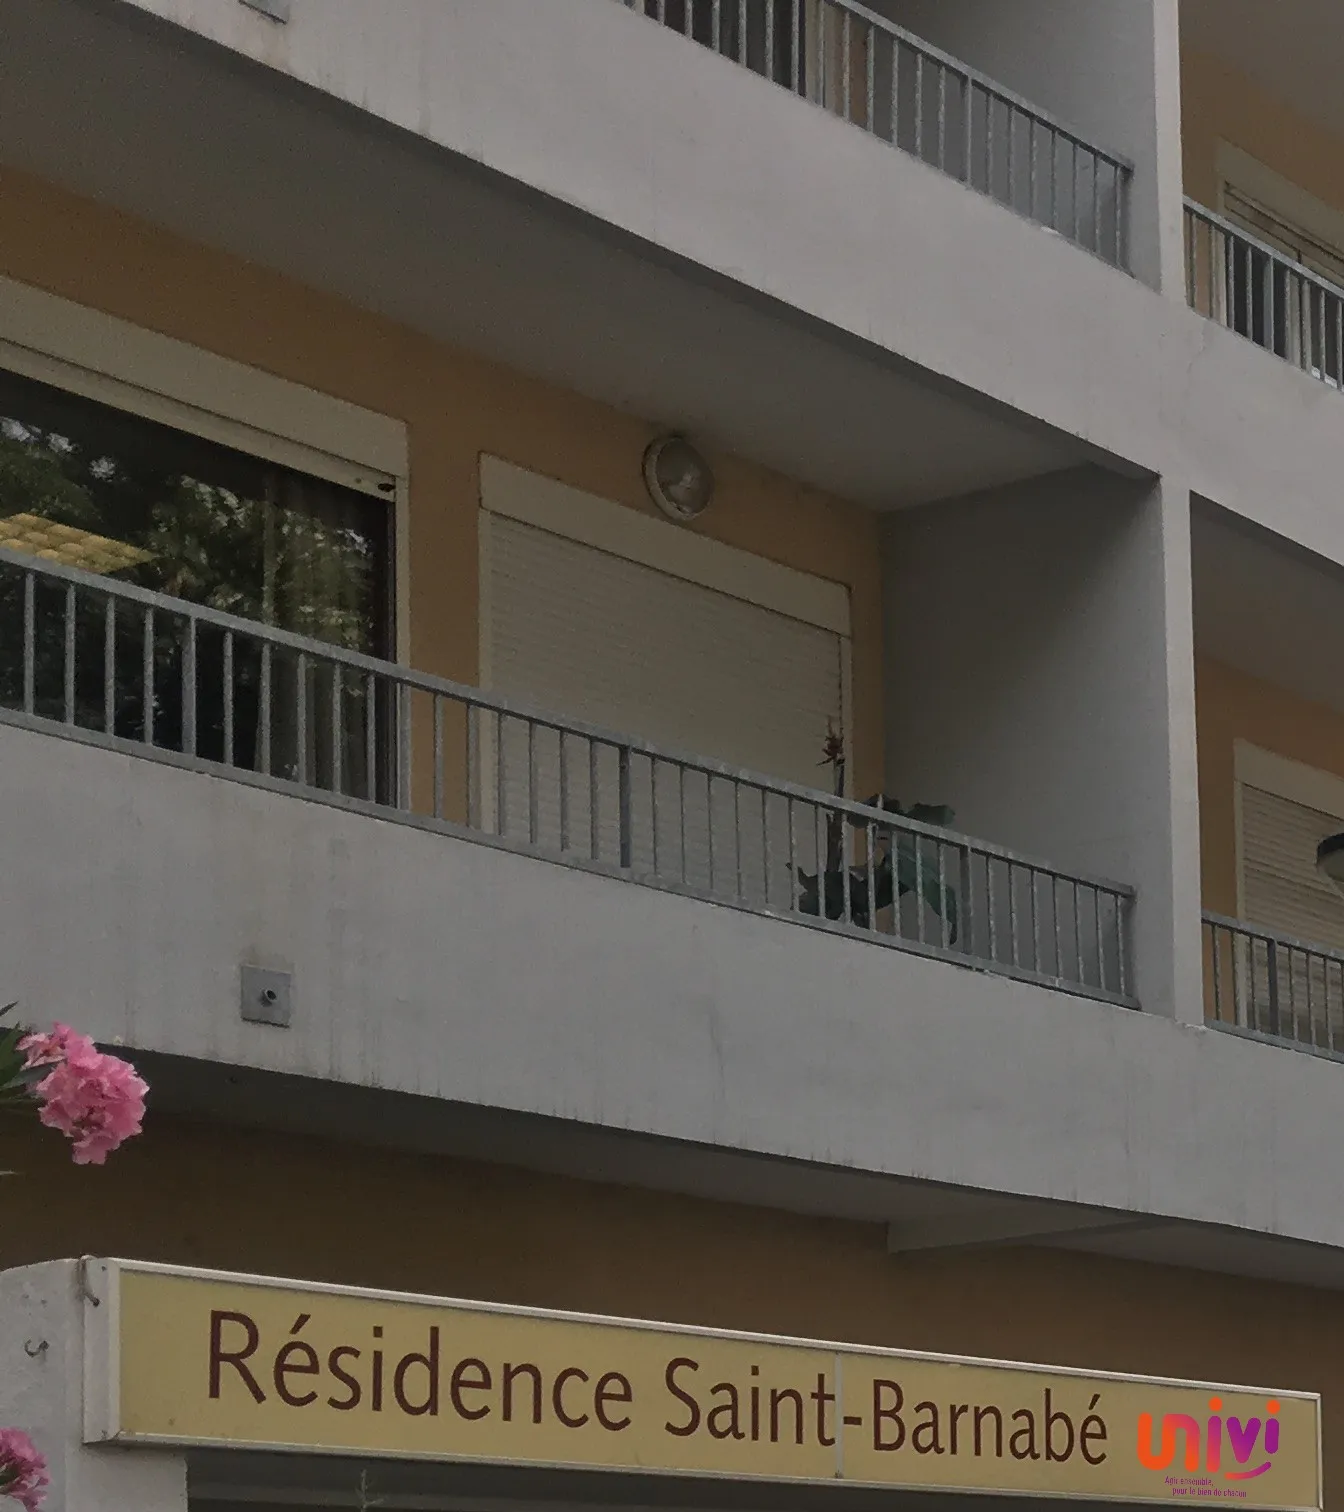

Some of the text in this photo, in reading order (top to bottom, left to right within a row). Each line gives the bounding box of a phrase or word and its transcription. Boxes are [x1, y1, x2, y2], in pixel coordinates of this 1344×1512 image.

[208, 1309, 1109, 1466] Résidence Saint-Barnabé
[1136, 1396, 1281, 1473] univi
[1164, 1475, 1178, 1486] Agir
[1172, 1487, 1188, 1496] pour
